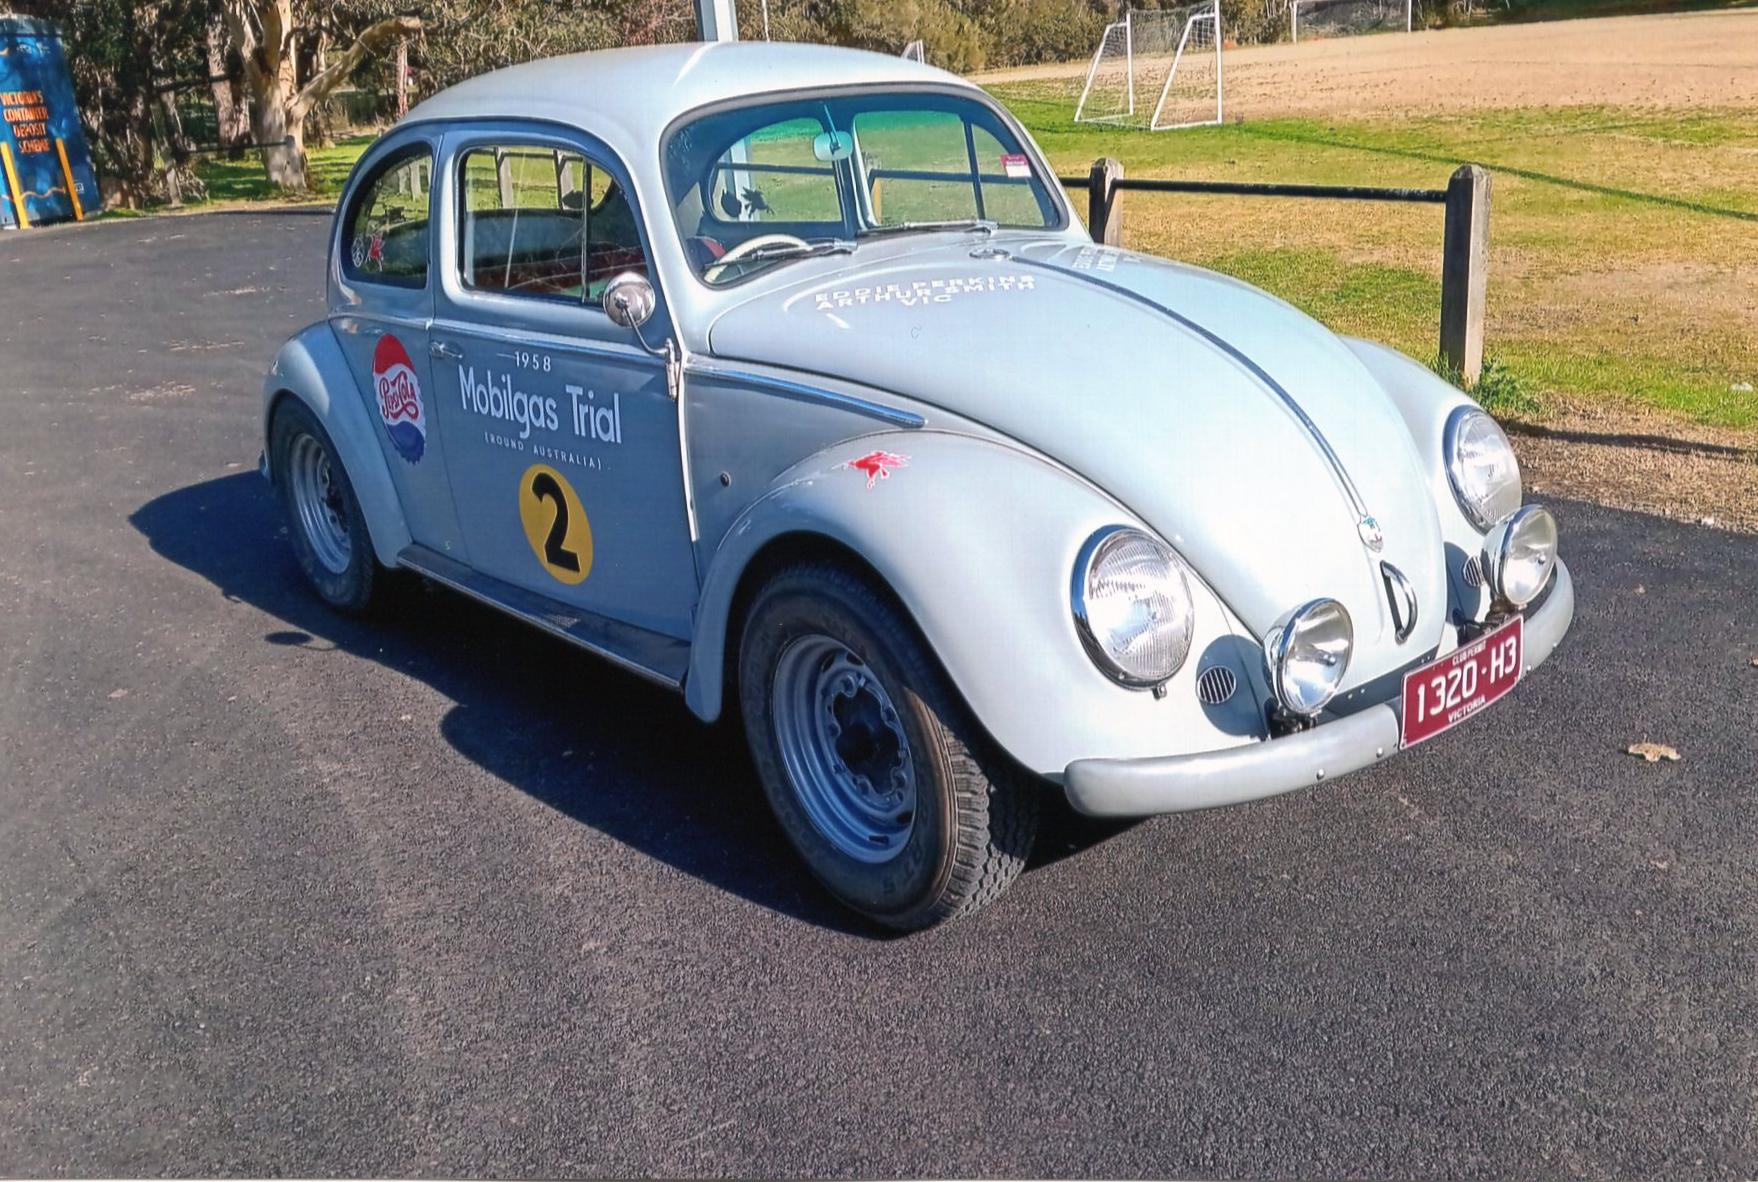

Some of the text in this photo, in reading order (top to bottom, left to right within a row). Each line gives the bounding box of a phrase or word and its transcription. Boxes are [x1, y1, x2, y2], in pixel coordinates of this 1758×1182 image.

[3, 106, 49, 122] CONTAINER
[13, 123, 46, 137] DEPOSIT
[18, 138, 50, 153] SCHEME
[815, 289, 931, 310] ARTHUR
[901, 294, 952, 306] VIC
[514, 351, 551, 372] 1958
[458, 364, 622, 444] Mobilgas Trial
[531, 471, 580, 573] 2
[1447, 694, 1486, 723] VICTORIA
